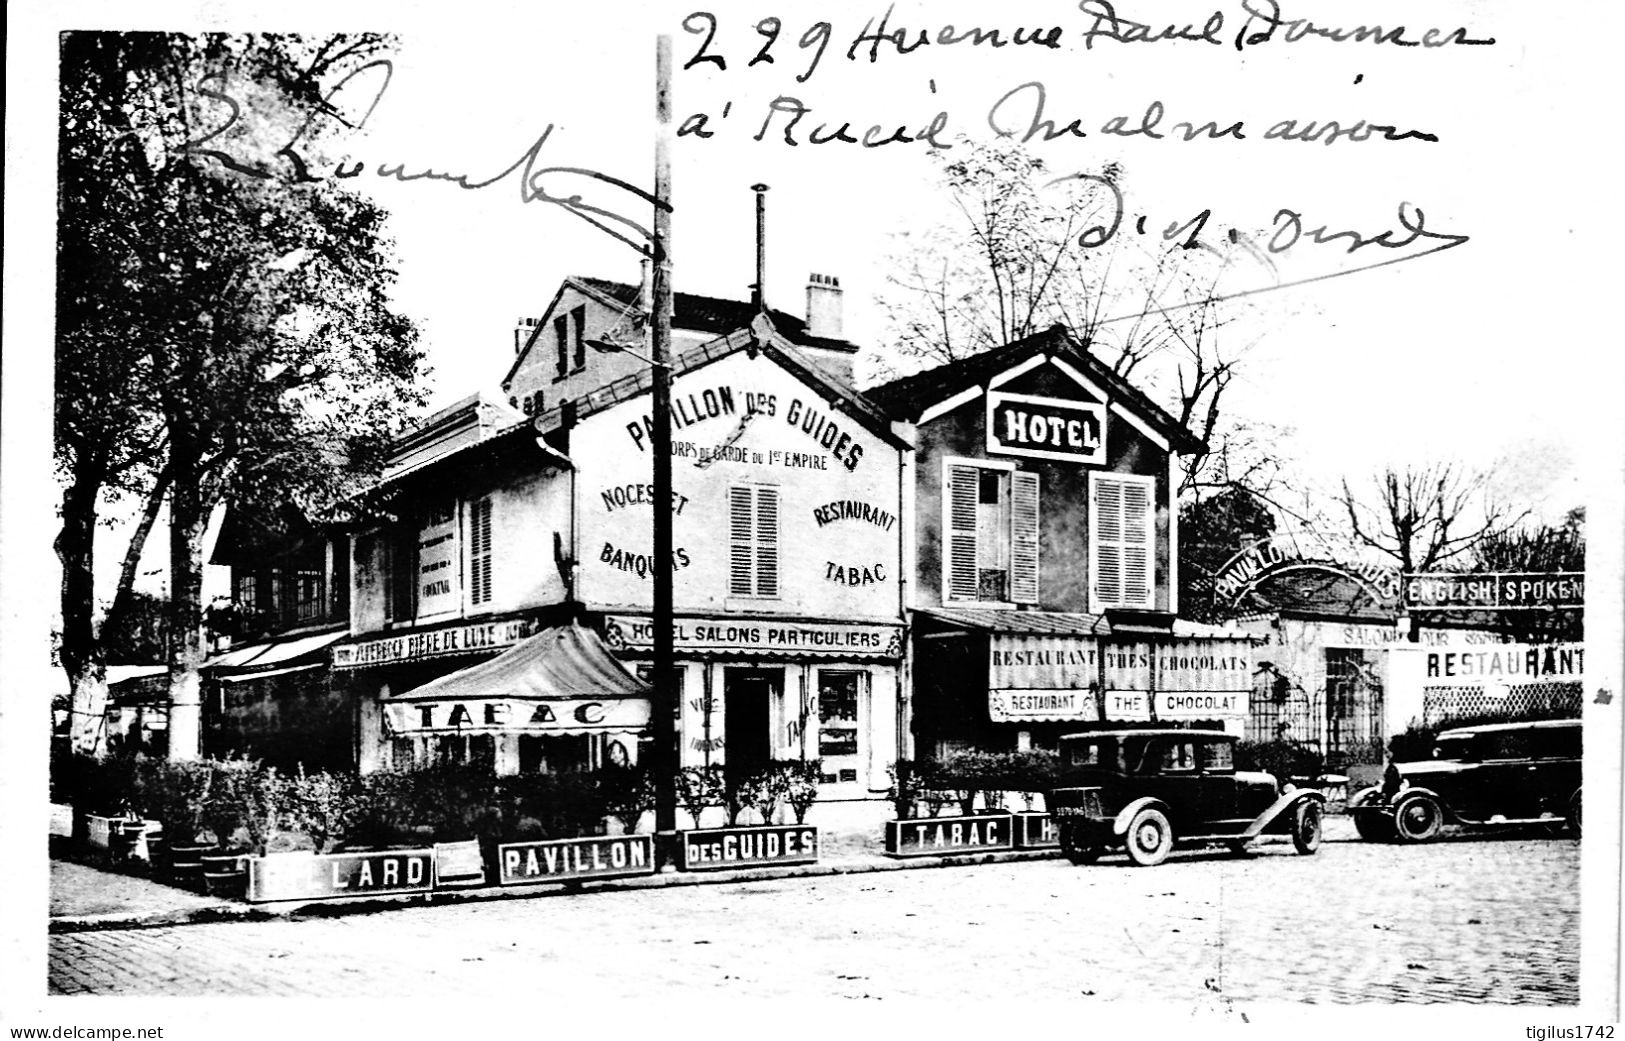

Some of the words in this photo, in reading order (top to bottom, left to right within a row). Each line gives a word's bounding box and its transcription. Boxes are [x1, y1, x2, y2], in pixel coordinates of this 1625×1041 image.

[786, 399, 863, 472] GUIDES
[1005, 409, 1100, 448] HOTEL
[670, 441, 698, 459] ORPS
[713, 446, 749, 464] GARDE
[785, 452, 828, 471] EMPIRE
[813, 500, 897, 532] RESTAURANT
[826, 561, 886, 586] TABAC
[1408, 579, 1492, 602] ENGLISH
[1504, 579, 1584, 601] SPOKEN
[443, 629, 459, 651] DE
[463, 625, 496, 648] LUXE
[695, 626, 760, 644] SALONS
[768, 628, 881, 648] PARTICULIERS
[993, 650, 1097, 668] RESTAURANT
[1107, 651, 1149, 669] THES
[1159, 652, 1248, 672] CHOCOLATS
[1427, 649, 1584, 679] RESTAURANT
[1011, 694, 1075, 710] RESTAURANT
[1114, 696, 1141, 711] THE
[1166, 695, 1238, 711] CHOCOLAT
[414, 703, 605, 728] TABAC
[688, 843, 721, 863] DES
[723, 830, 814, 861] GUIDES
[915, 821, 998, 848] TABAC
[505, 839, 646, 877] PAVILLON
